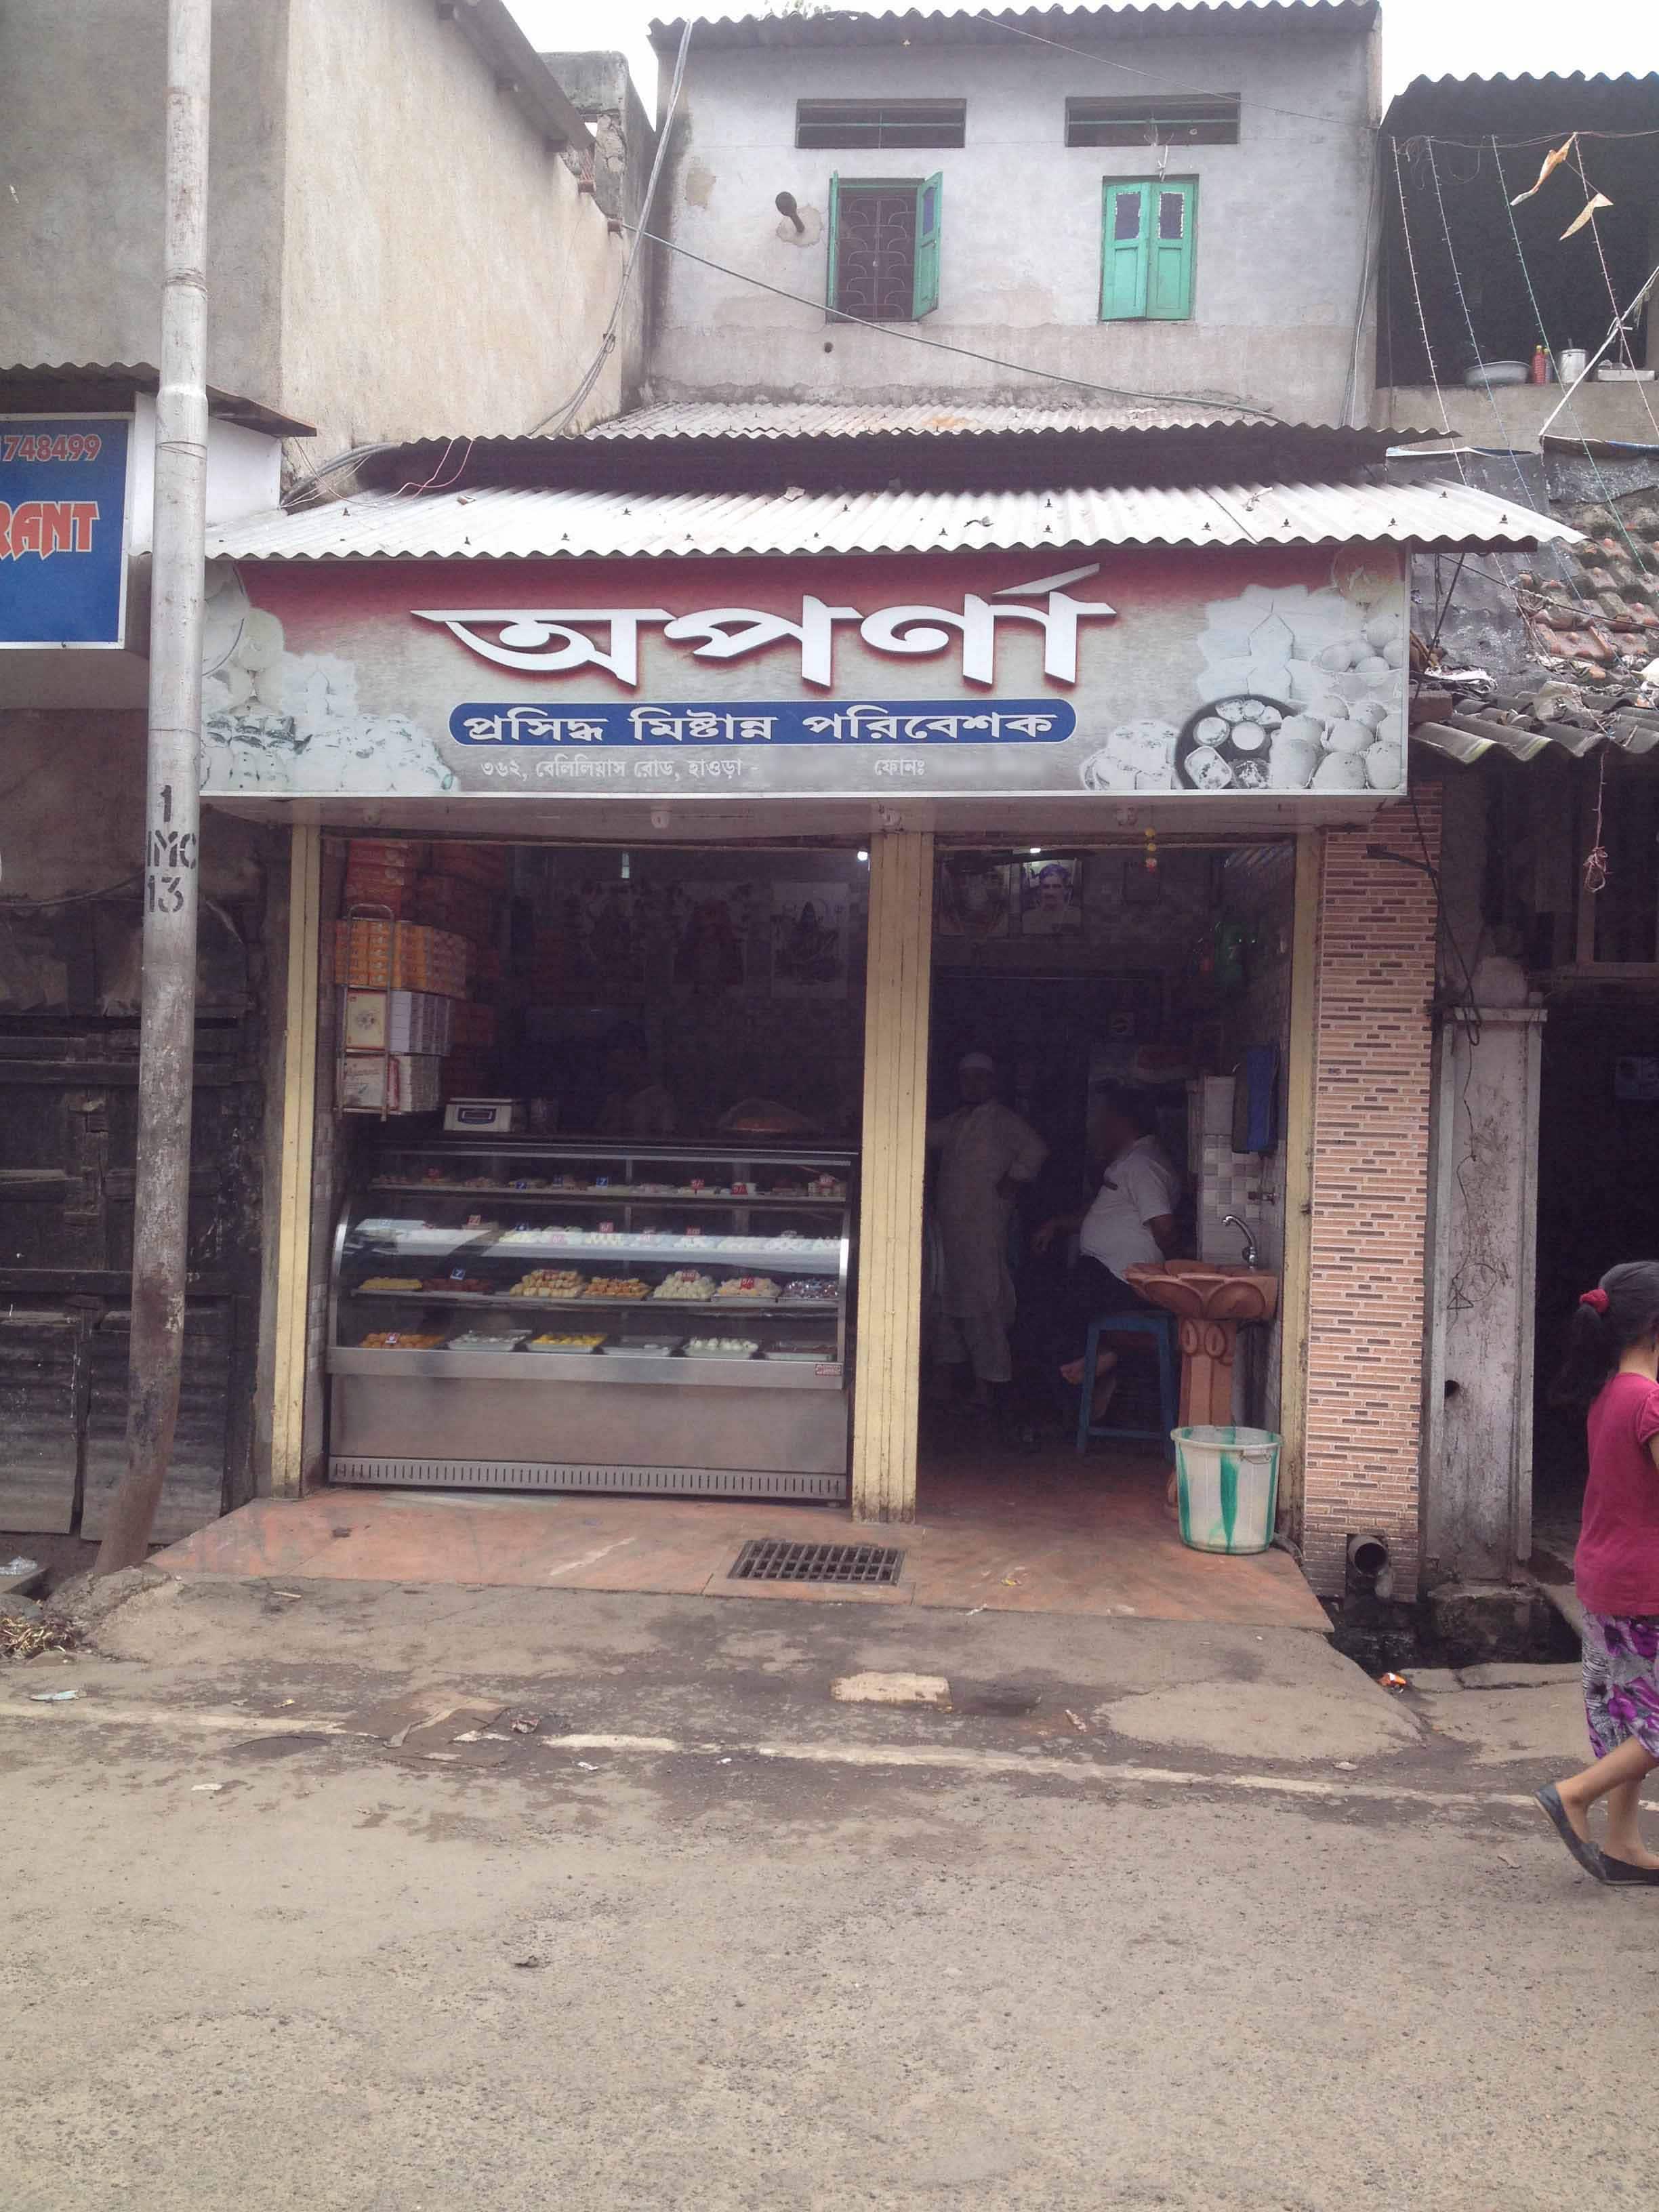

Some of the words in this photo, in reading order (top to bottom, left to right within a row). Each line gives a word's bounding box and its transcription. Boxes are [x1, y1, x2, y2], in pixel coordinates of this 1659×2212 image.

[2, 434, 102, 462] 748499
[411, 562, 1118, 687] অপর্ণা
[463, 706, 609, 741] প্রসিদ্ধ
[628, 706, 779, 741] মিষ্টান্ন
[802, 704, 1058, 739] পরিবেশক
[147, 875, 184, 913] 13
